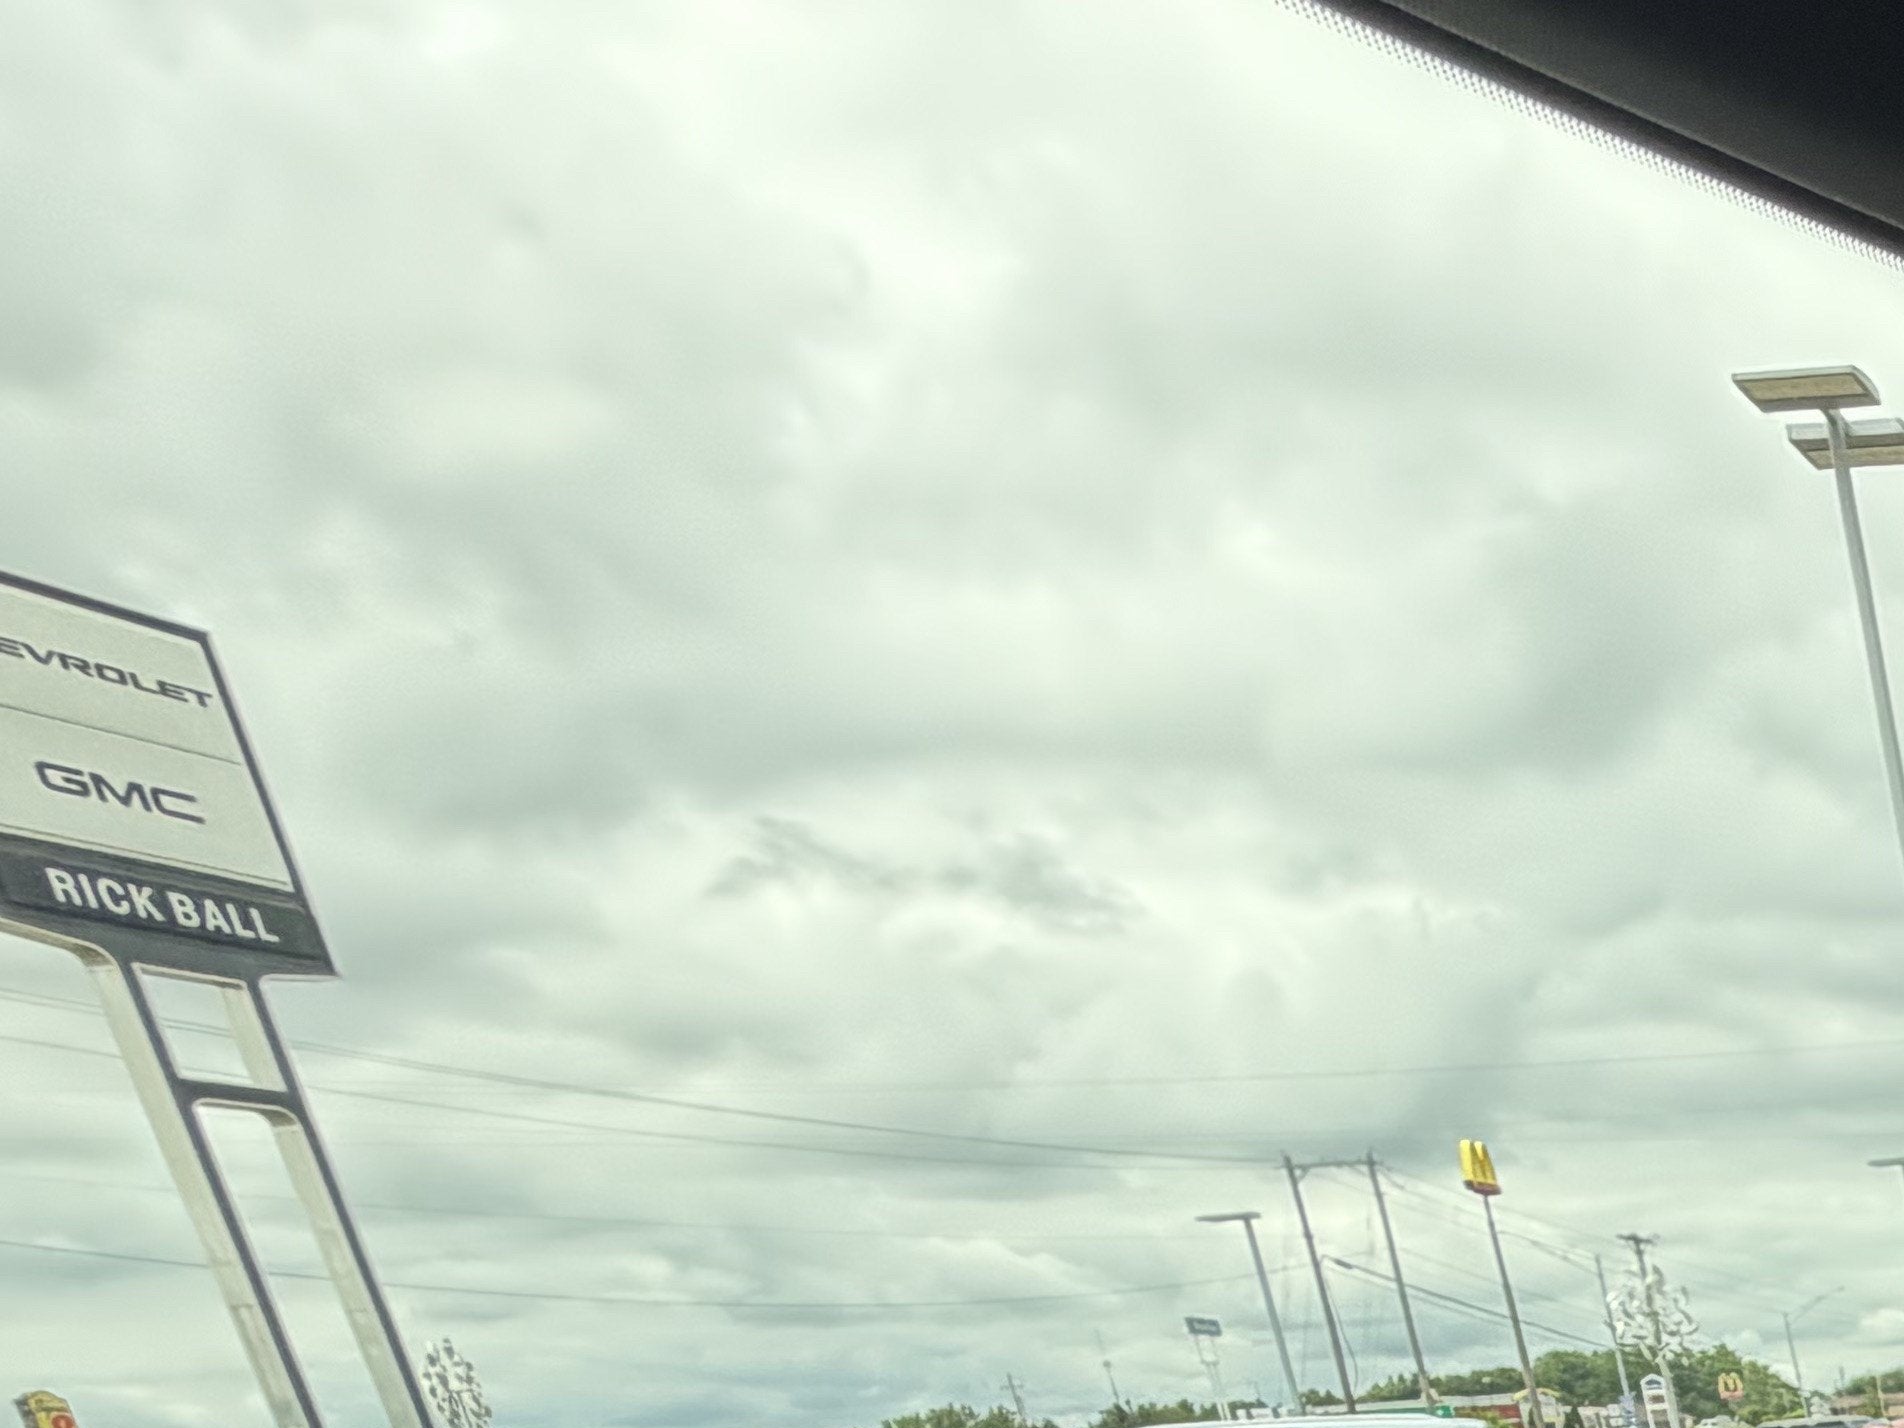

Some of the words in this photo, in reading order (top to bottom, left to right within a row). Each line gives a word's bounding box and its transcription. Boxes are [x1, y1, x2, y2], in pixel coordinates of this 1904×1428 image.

[35, 761, 206, 825] GMC
[46, 867, 166, 922] RICK
[166, 891, 280, 943] BALL
